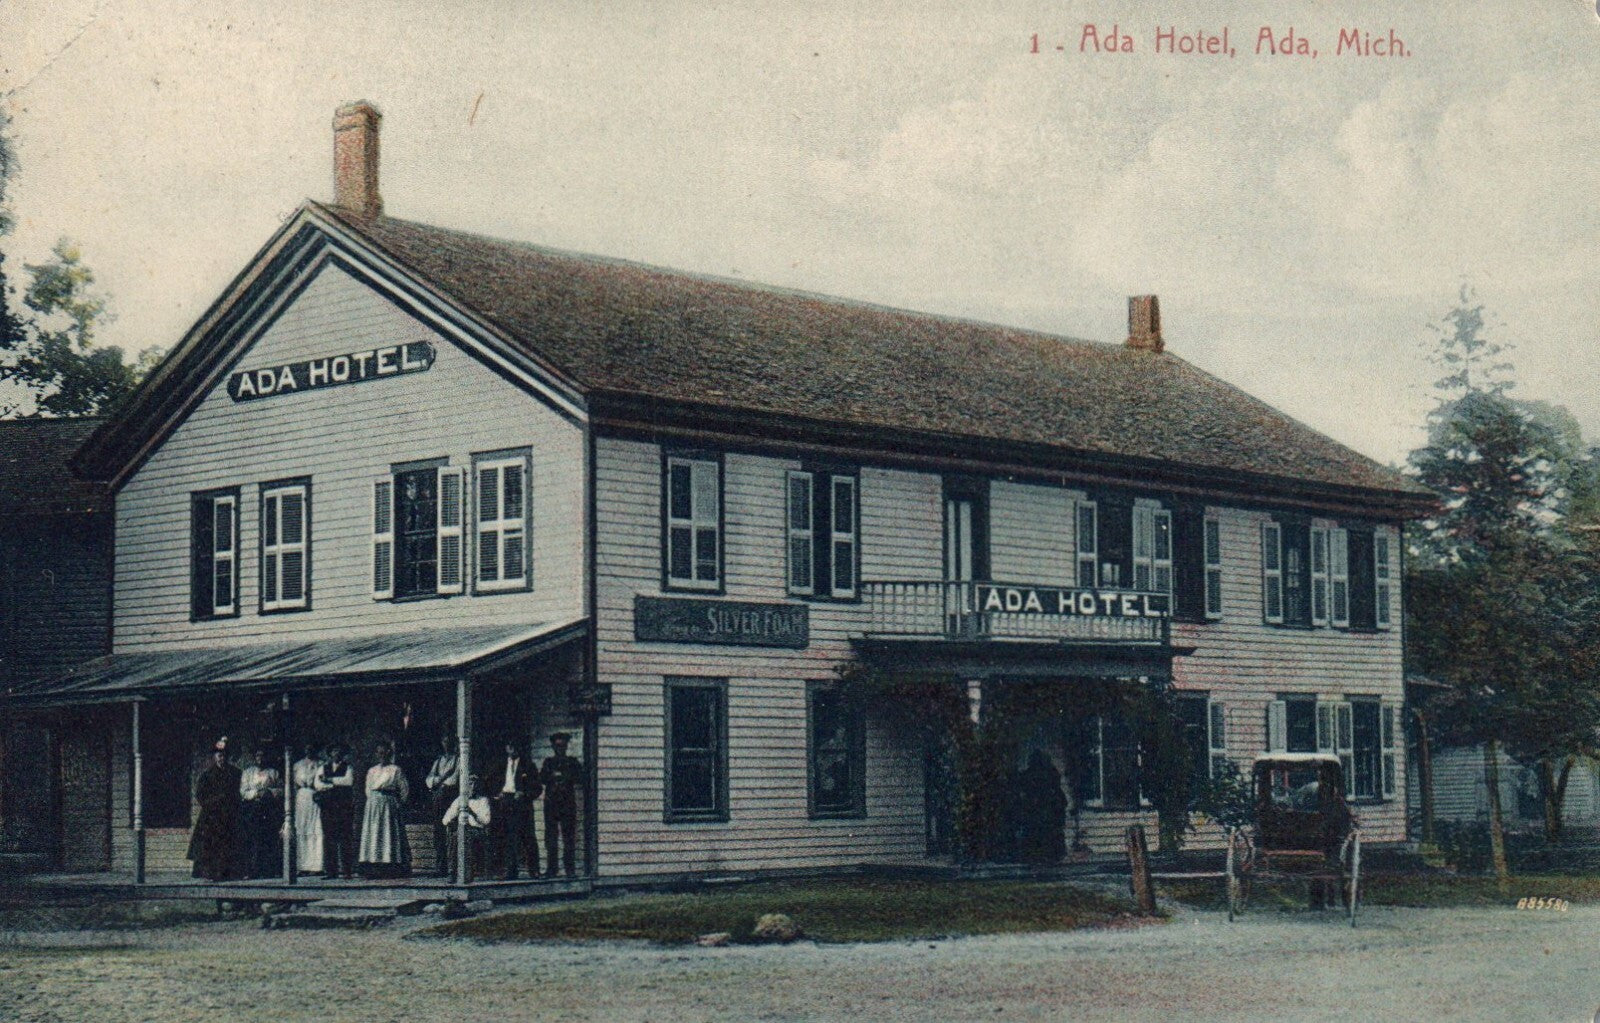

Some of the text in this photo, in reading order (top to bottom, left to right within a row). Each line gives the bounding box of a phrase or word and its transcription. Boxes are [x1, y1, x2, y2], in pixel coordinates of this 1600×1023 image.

[238, 345, 427, 397] ADA HOTEL.
[985, 588, 1168, 617] ADA HOTEL.
